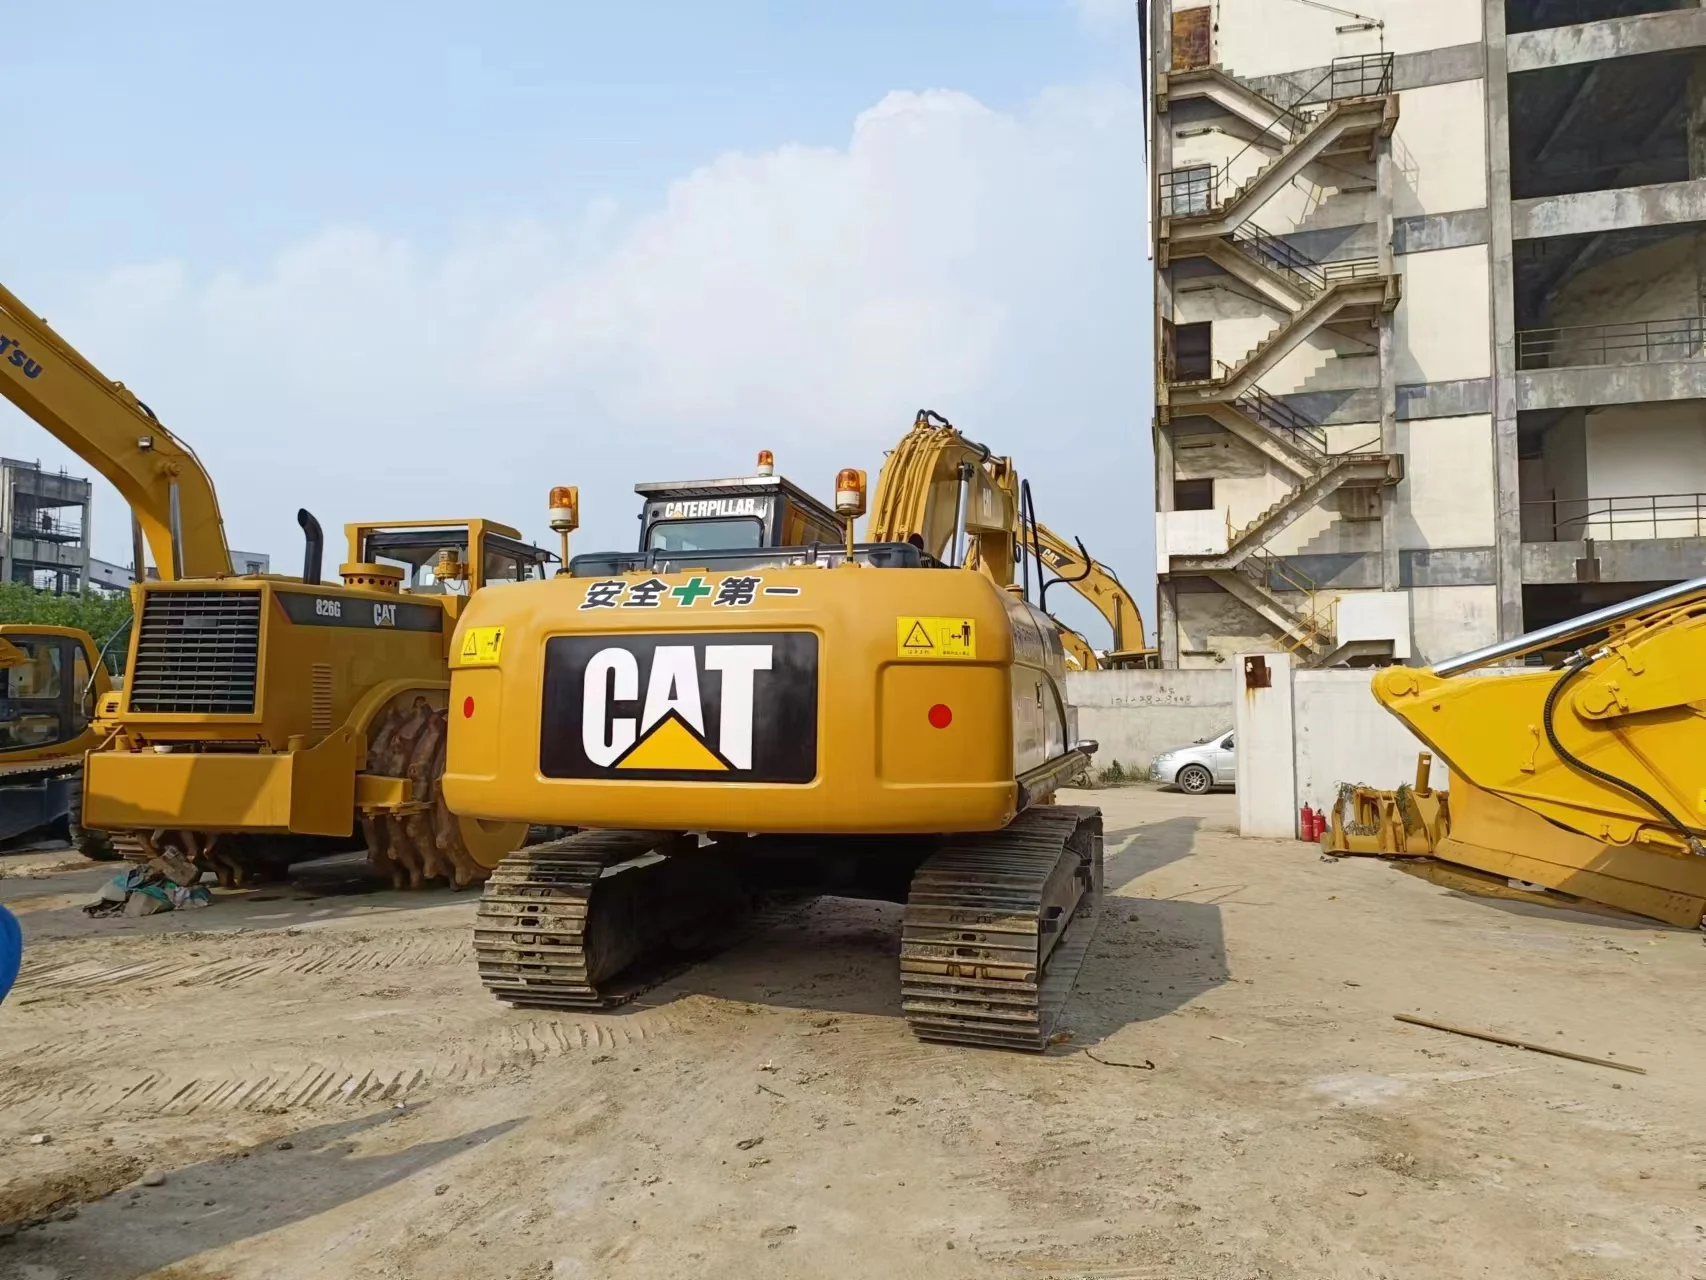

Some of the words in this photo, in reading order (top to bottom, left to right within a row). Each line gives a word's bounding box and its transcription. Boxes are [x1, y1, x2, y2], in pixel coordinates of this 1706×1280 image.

[665, 498, 755, 518] CATERPILLAR
[1041, 548, 1060, 565] CAT
[316, 598, 341, 617] 826G
[374, 603, 397, 626] CAT
[582, 644, 773, 770] CAT
